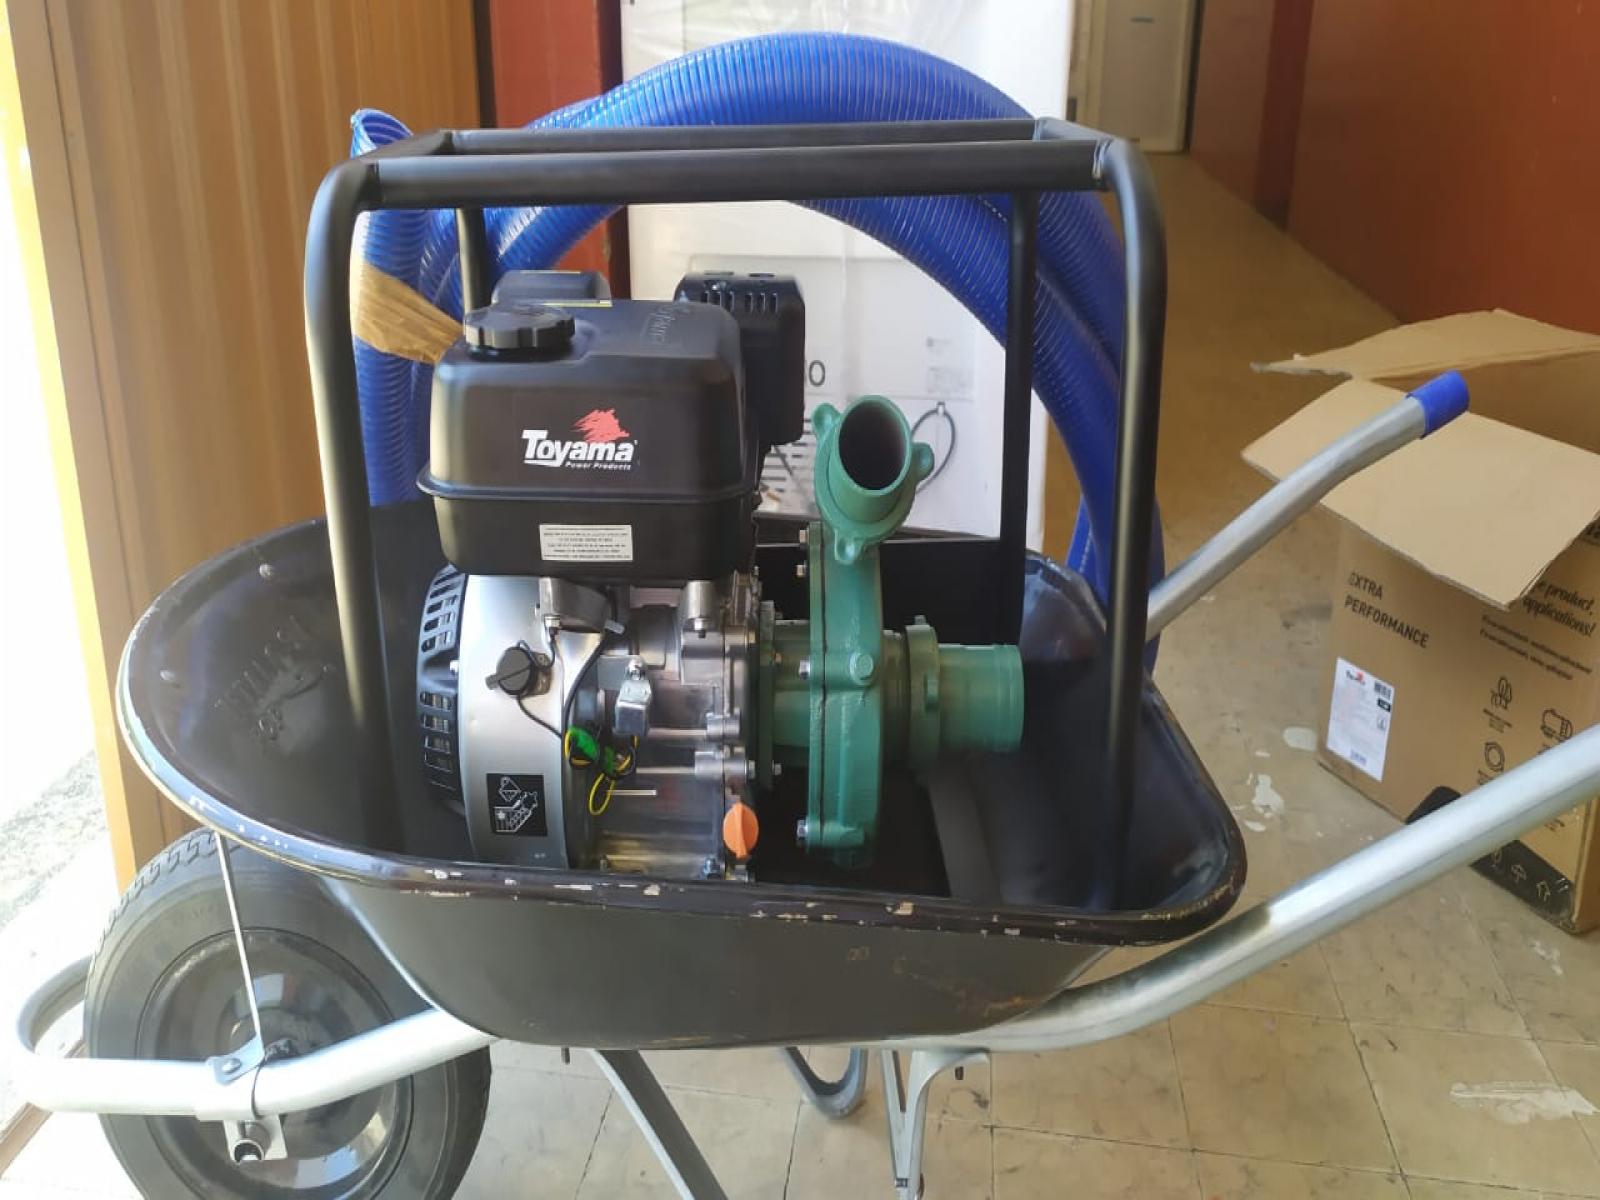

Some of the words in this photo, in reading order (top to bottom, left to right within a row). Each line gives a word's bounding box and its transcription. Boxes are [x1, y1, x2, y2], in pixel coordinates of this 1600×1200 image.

[521, 429, 635, 467] Toyama
[564, 461, 591, 470] Power
[1348, 571, 1384, 600] EXTRA
[1344, 594, 1430, 649] PERFORMANCE
